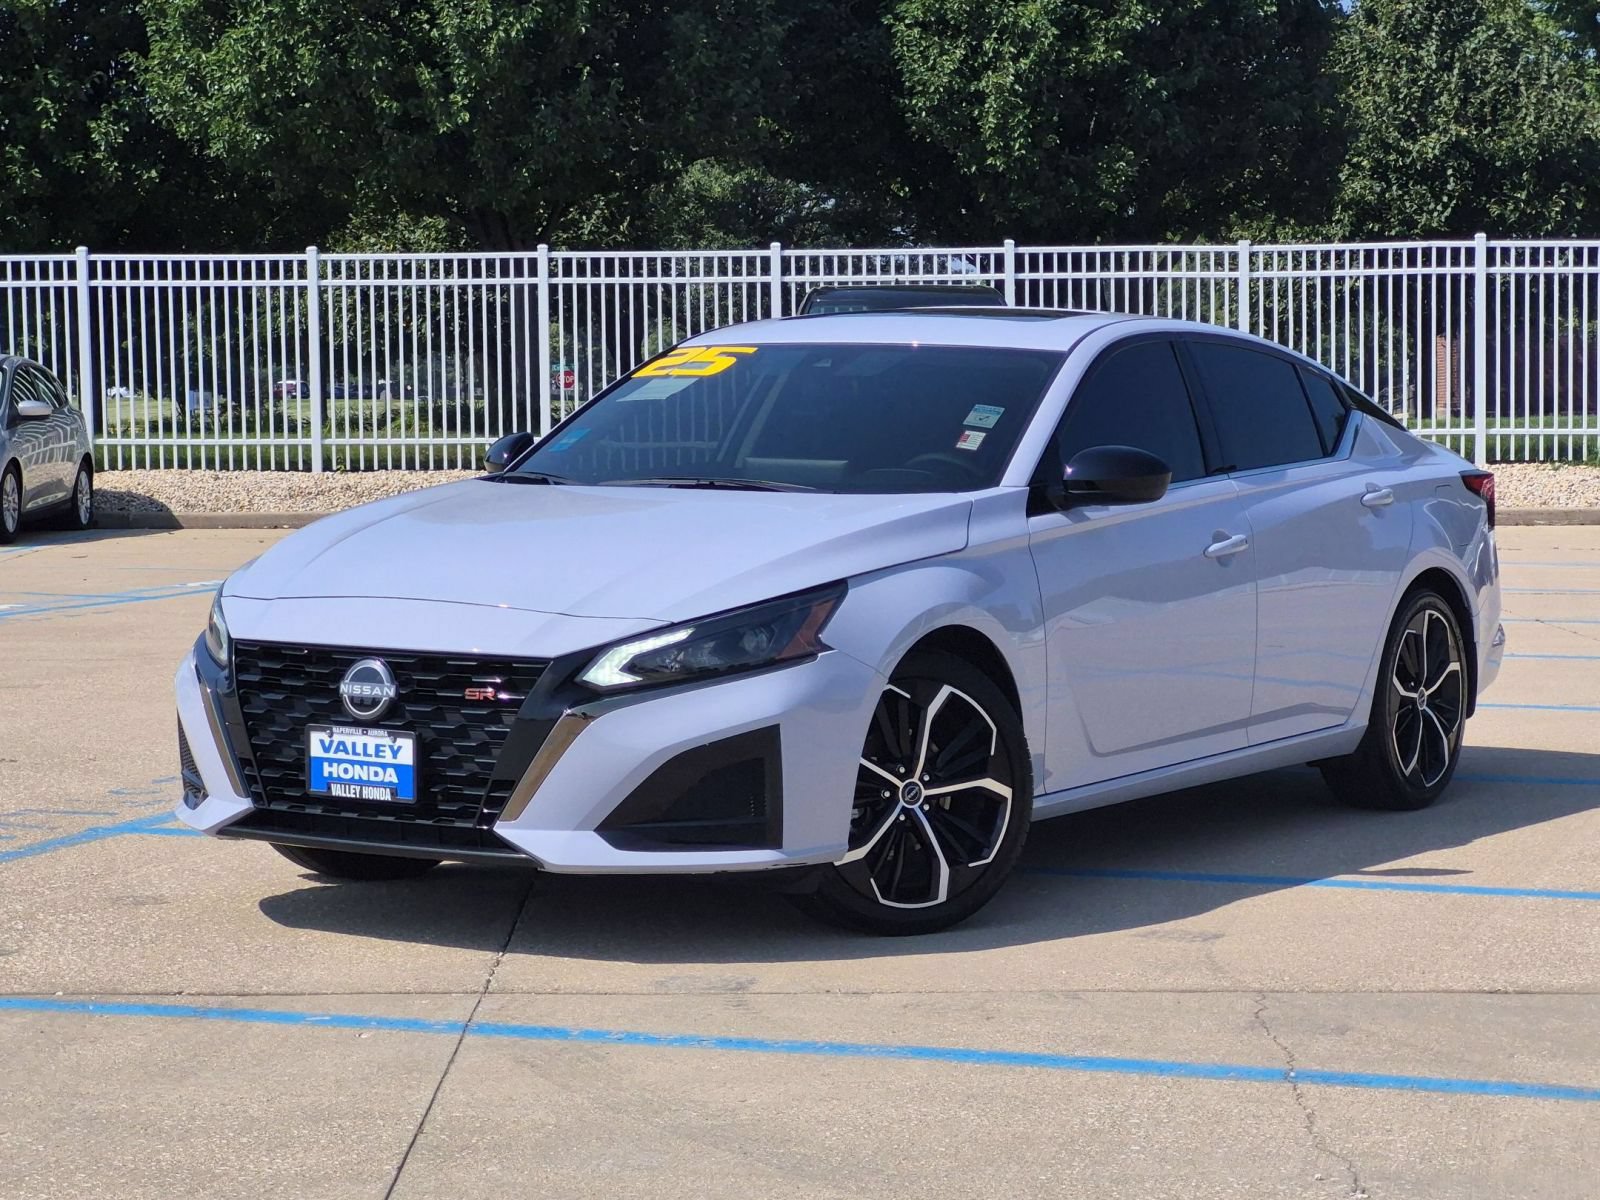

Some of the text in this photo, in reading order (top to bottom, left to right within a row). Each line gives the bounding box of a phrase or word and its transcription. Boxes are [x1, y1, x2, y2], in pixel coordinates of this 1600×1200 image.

[631, 346, 759, 378] 25
[339, 684, 394, 697] NISSAN
[465, 687, 496, 701] SR
[332, 727, 388, 737] NAPERVILLE AURORA
[319, 739, 402, 760] VALLEY
[323, 762, 398, 783] HONDA
[331, 783, 391, 800] VALLEY HONDA
